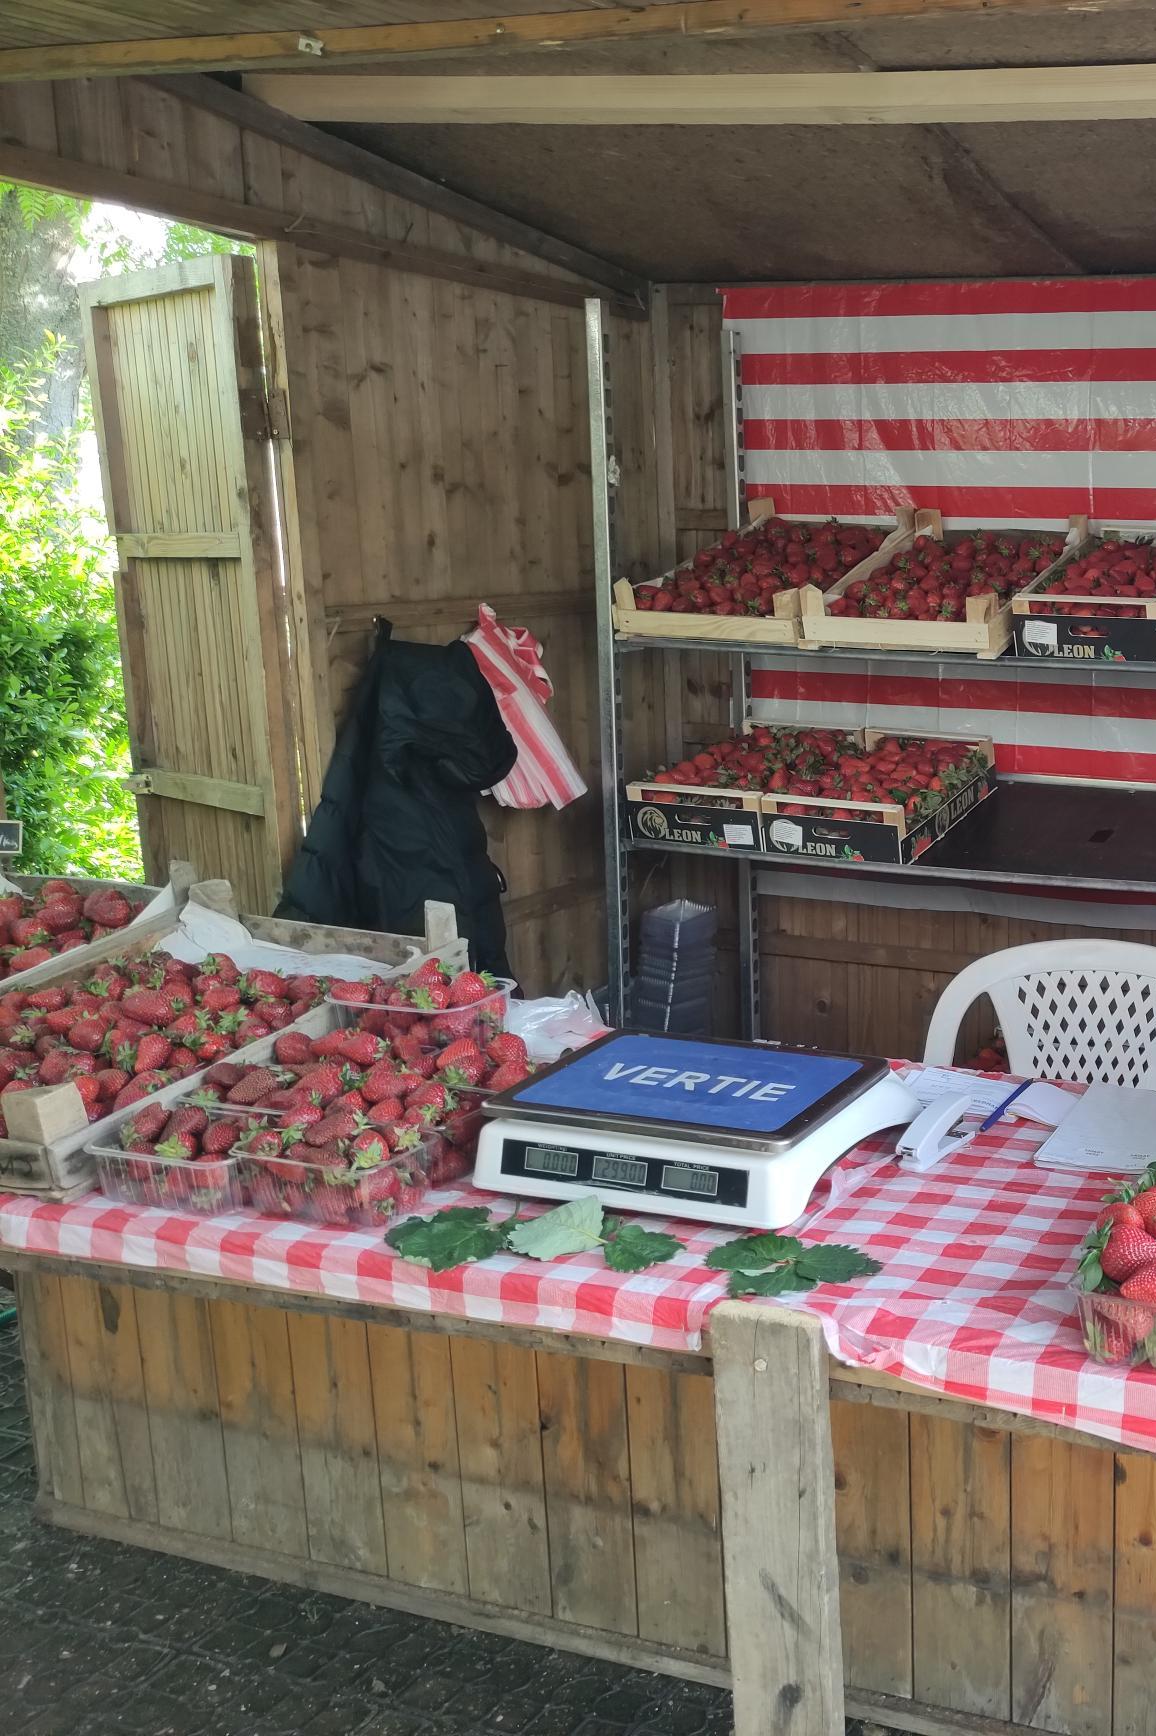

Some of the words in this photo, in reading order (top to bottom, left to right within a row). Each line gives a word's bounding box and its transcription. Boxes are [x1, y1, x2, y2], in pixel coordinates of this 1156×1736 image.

[1052, 644, 1095, 658] LEON
[951, 786, 975, 820] LEON
[665, 828, 701, 842] LEON
[797, 842, 836, 857] LEON
[603, 1062, 796, 1102] VERTIE
